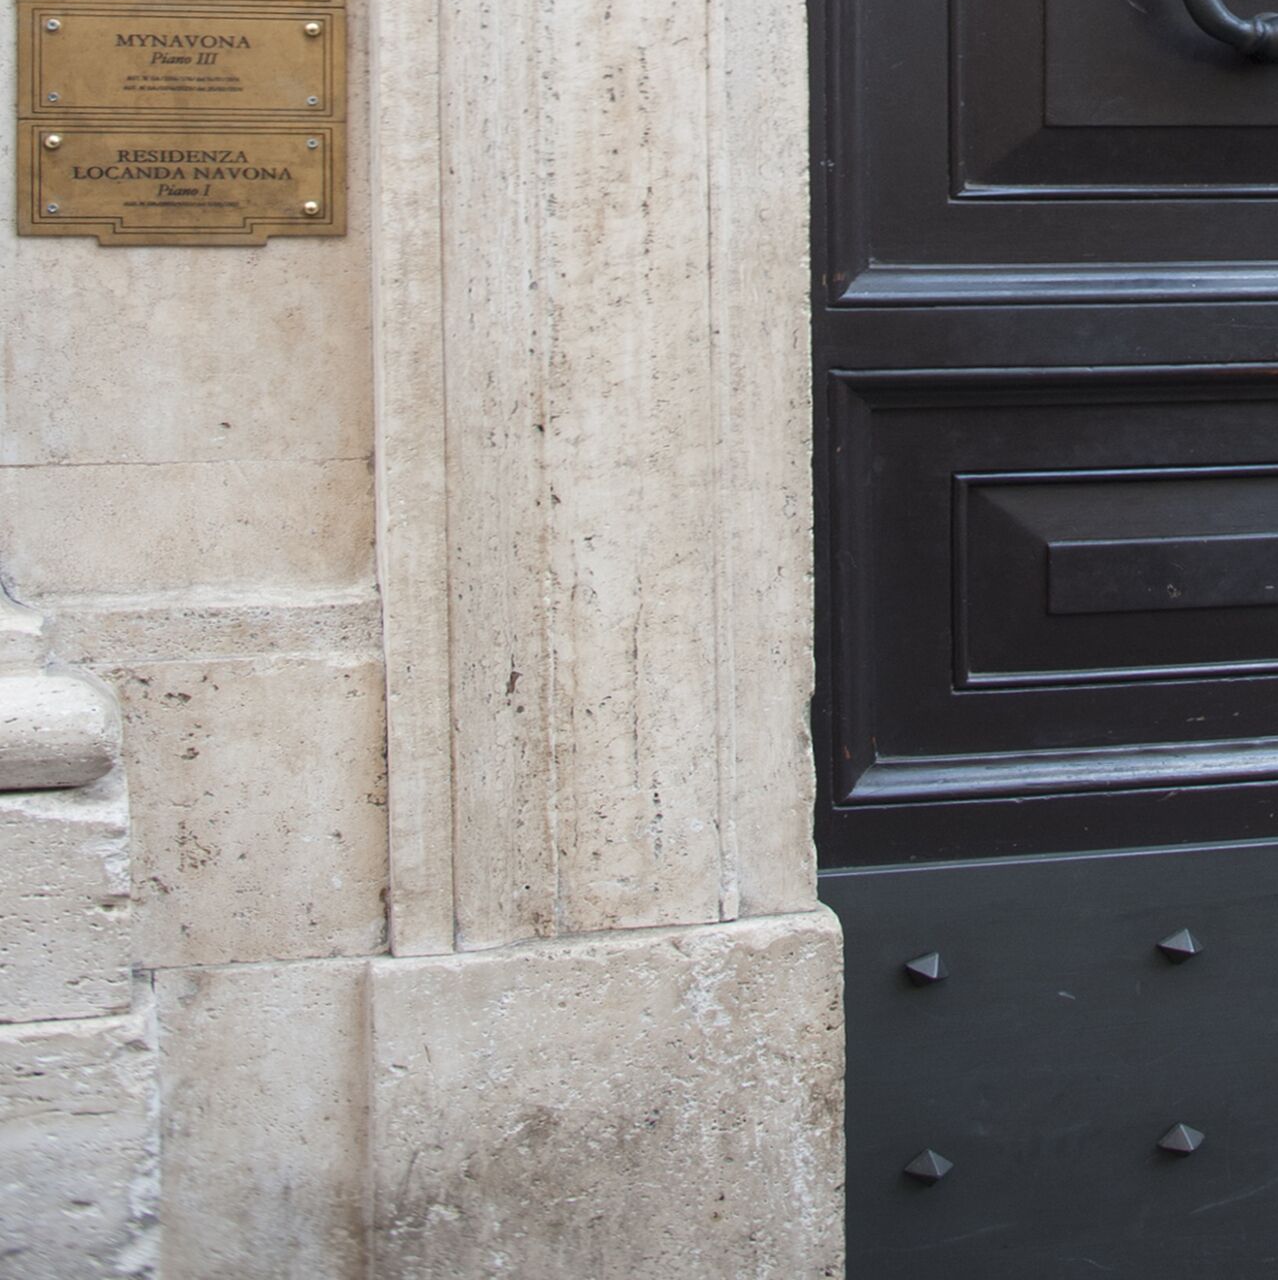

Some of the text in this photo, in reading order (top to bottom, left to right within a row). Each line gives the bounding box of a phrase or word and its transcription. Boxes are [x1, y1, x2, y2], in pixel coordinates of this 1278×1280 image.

[115, 33, 251, 49] MYNAVONA
[150, 51, 219, 65] Piano III
[117, 149, 248, 164] RESIDENZA
[72, 166, 293, 181] LOCANDA NAVONA
[157, 183, 211, 197] Piano I
